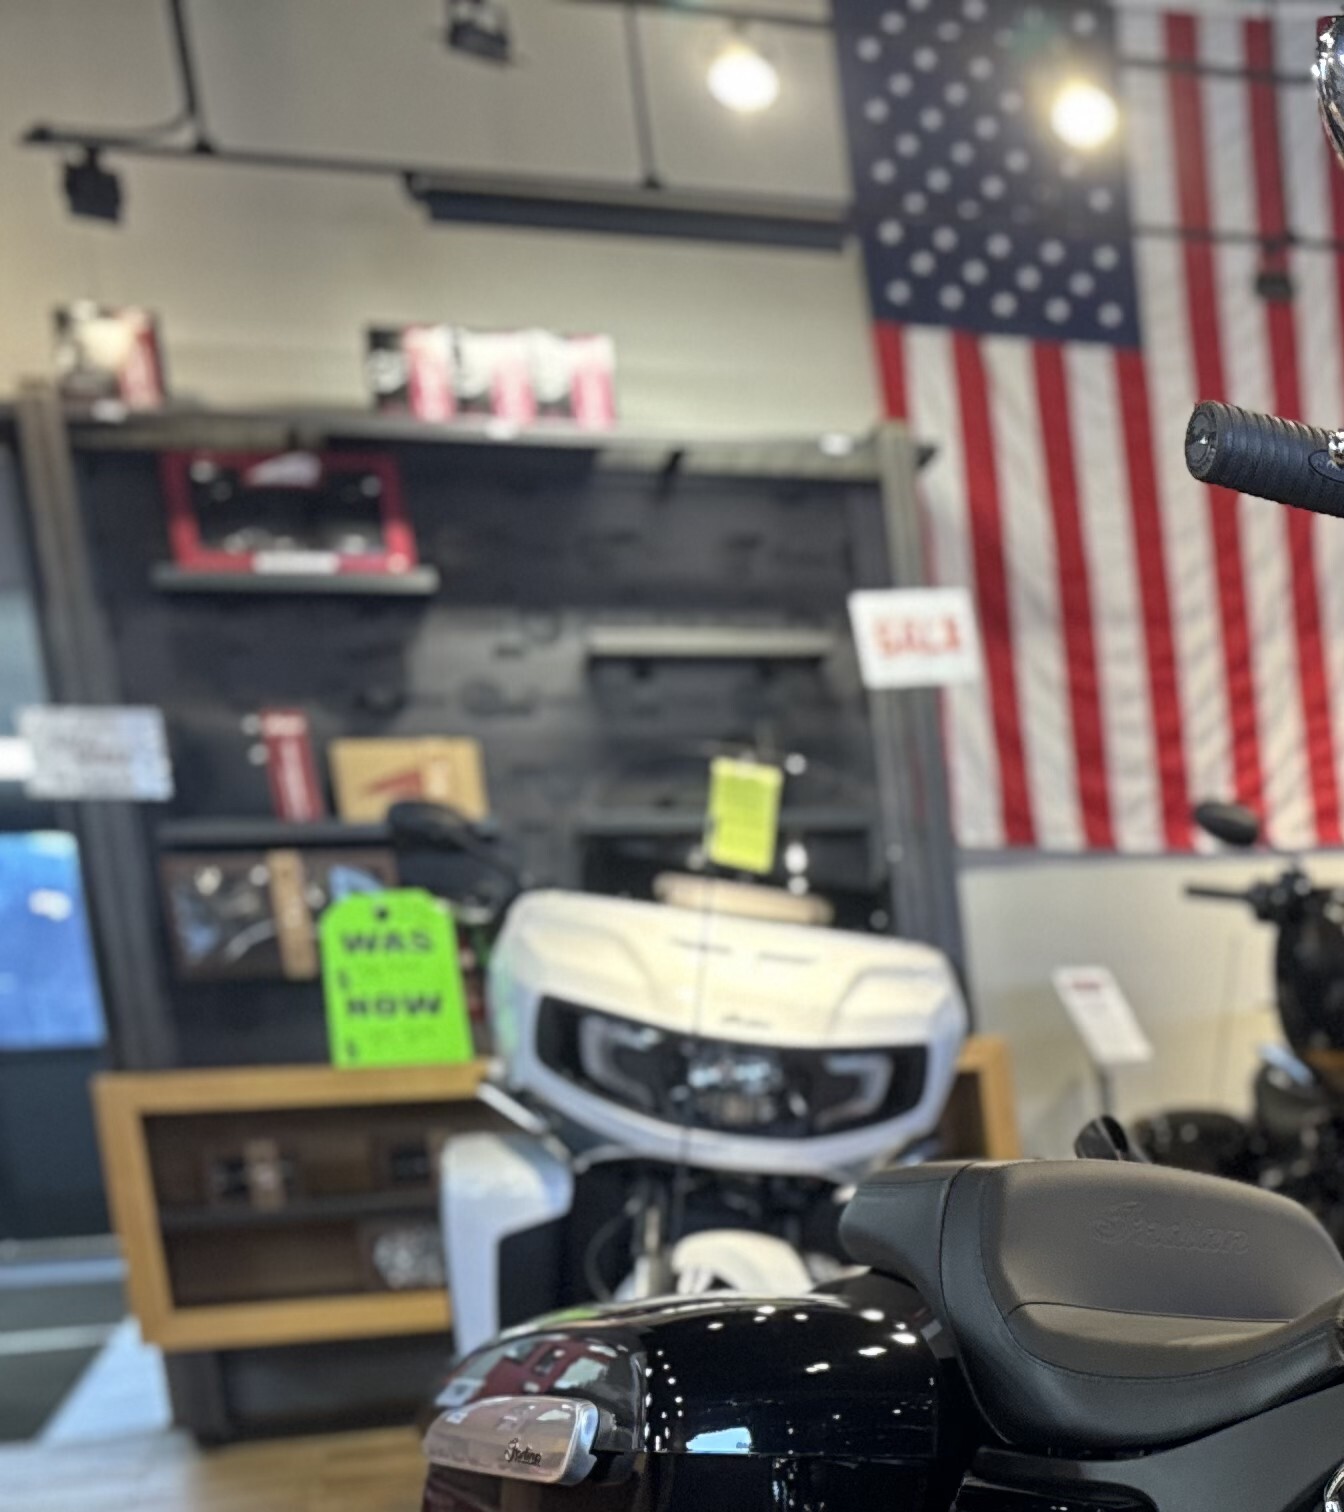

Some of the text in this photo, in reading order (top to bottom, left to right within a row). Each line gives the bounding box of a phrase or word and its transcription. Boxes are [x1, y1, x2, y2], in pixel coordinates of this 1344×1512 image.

[343, 930, 433, 953] WAS
[347, 995, 442, 1016] NOW
[1090, 1200, 1250, 1256] Indian
